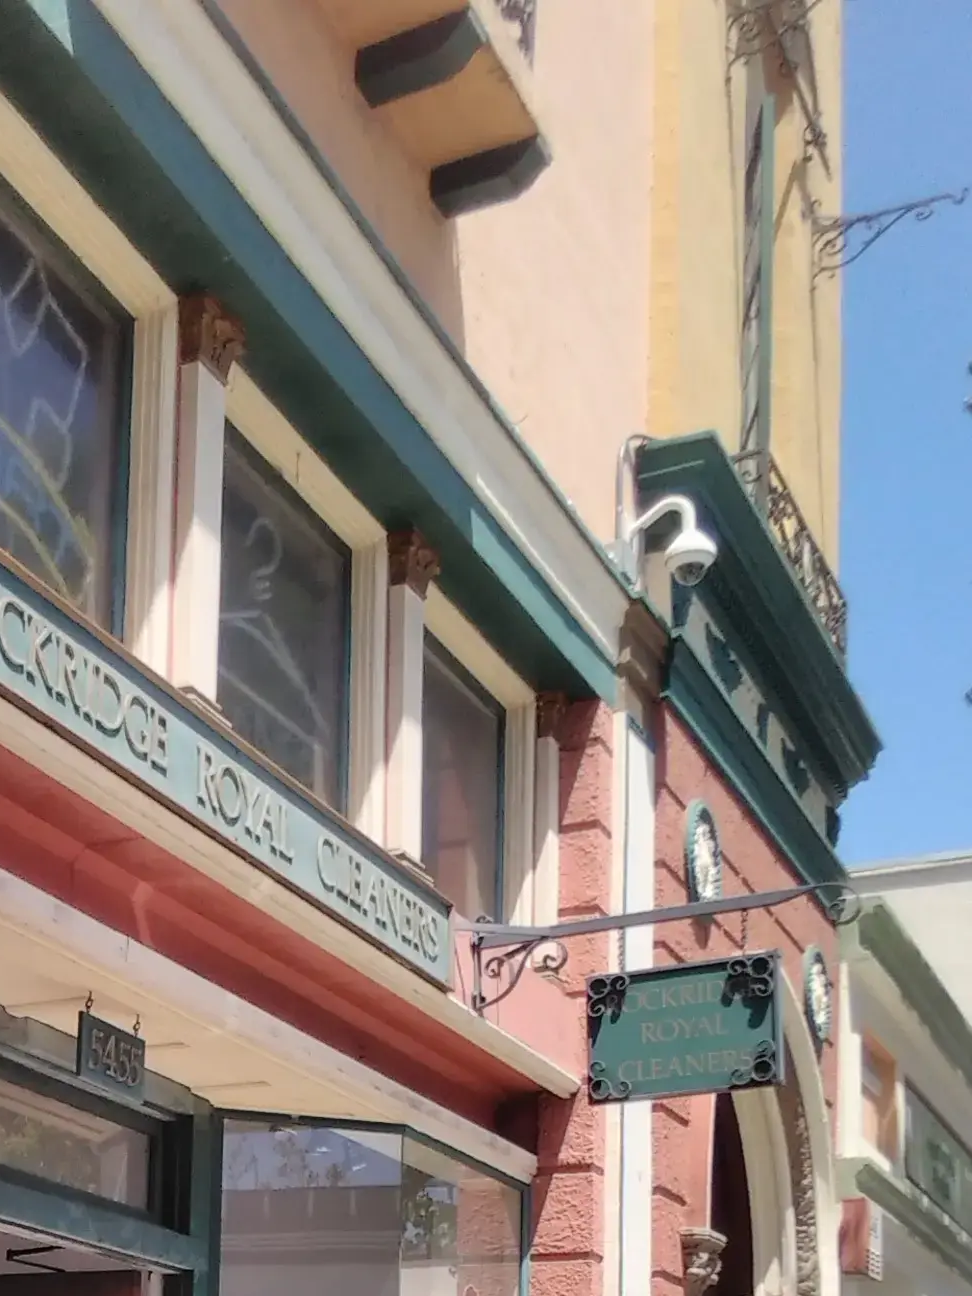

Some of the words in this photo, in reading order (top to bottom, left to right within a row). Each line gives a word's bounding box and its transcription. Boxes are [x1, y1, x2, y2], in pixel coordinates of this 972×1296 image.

[196, 739, 295, 866] ROYAL
[316, 831, 441, 963] CLEANERS
[640, 1012, 729, 1045] ROYAL
[88, 1028, 142, 1087] 5455
[617, 1050, 754, 1083] CLEANERS
